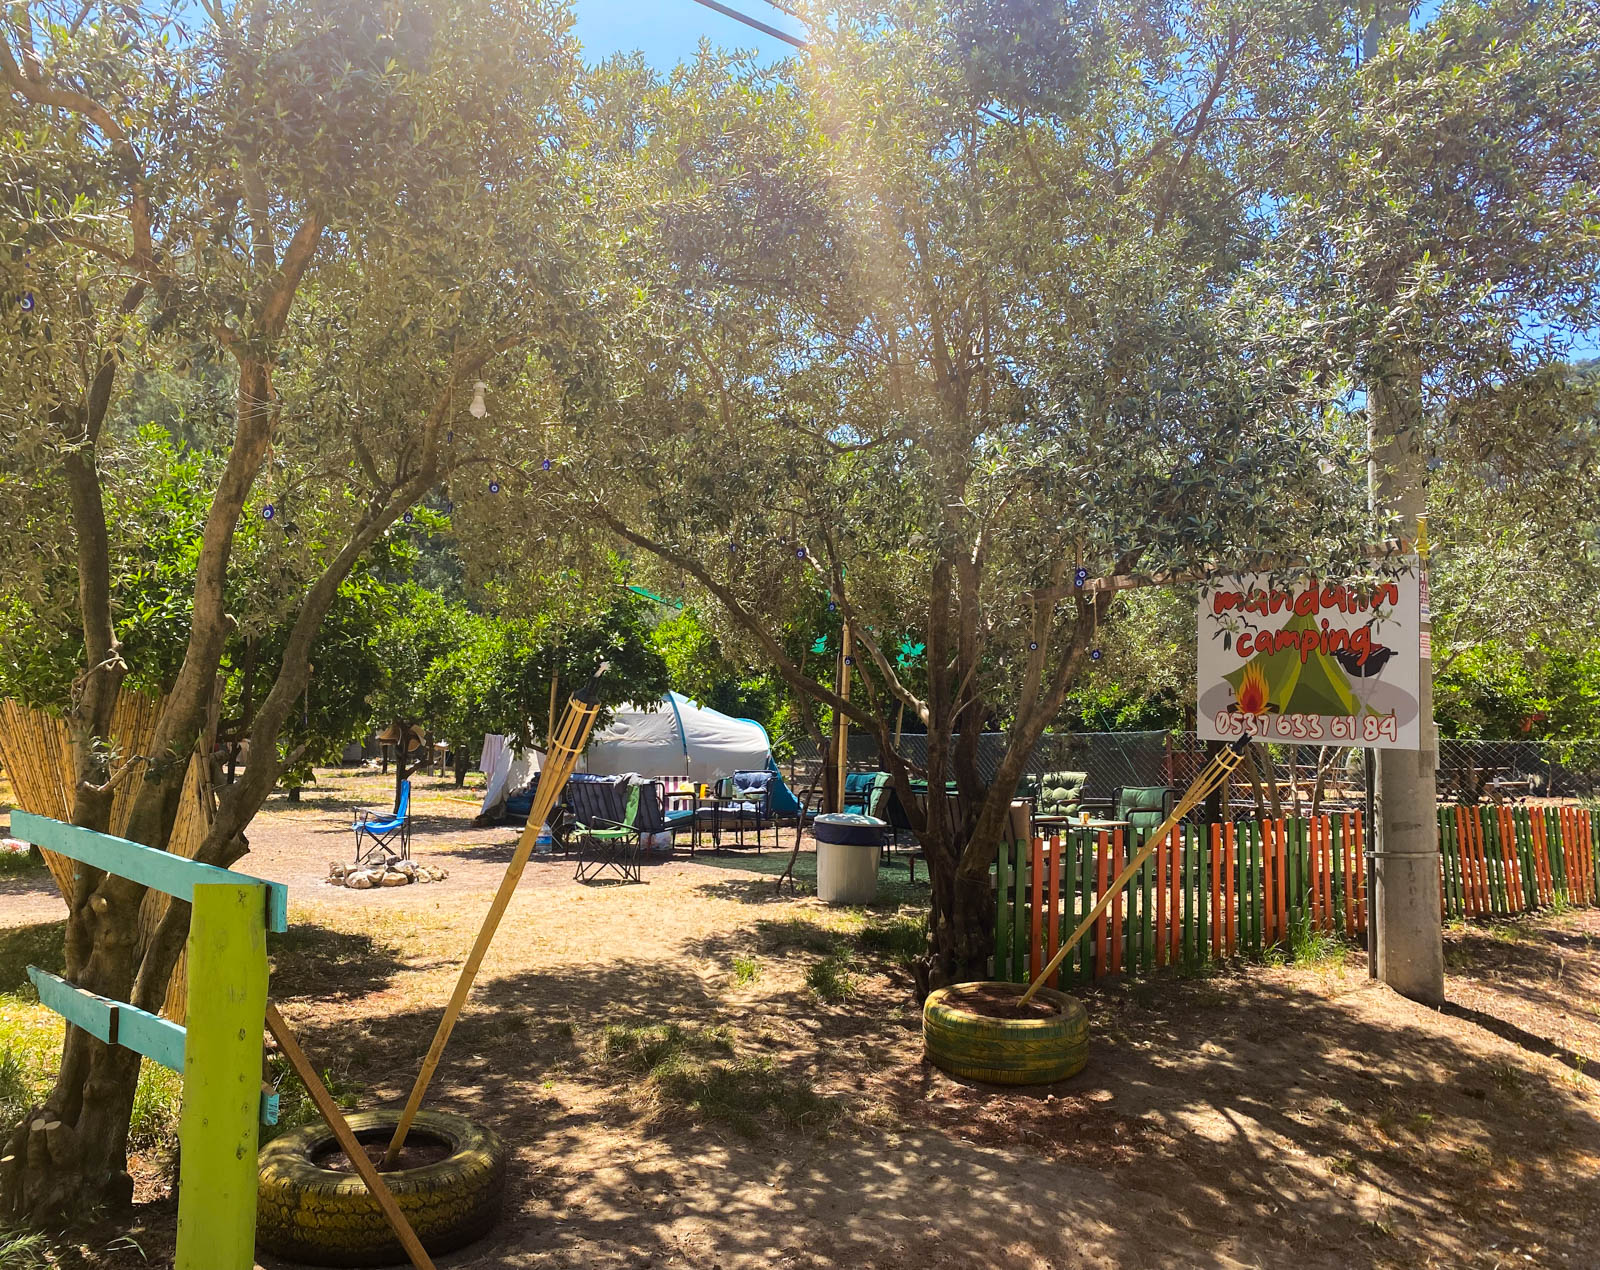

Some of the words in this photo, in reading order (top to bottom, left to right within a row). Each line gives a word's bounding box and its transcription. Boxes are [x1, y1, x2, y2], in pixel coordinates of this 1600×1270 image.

[1236, 618, 1371, 666] camping
[1215, 711, 1271, 737] 0537
[1276, 713, 1324, 740] 633
[1330, 715, 1357, 741] 61
[1362, 716, 1398, 743] 84
